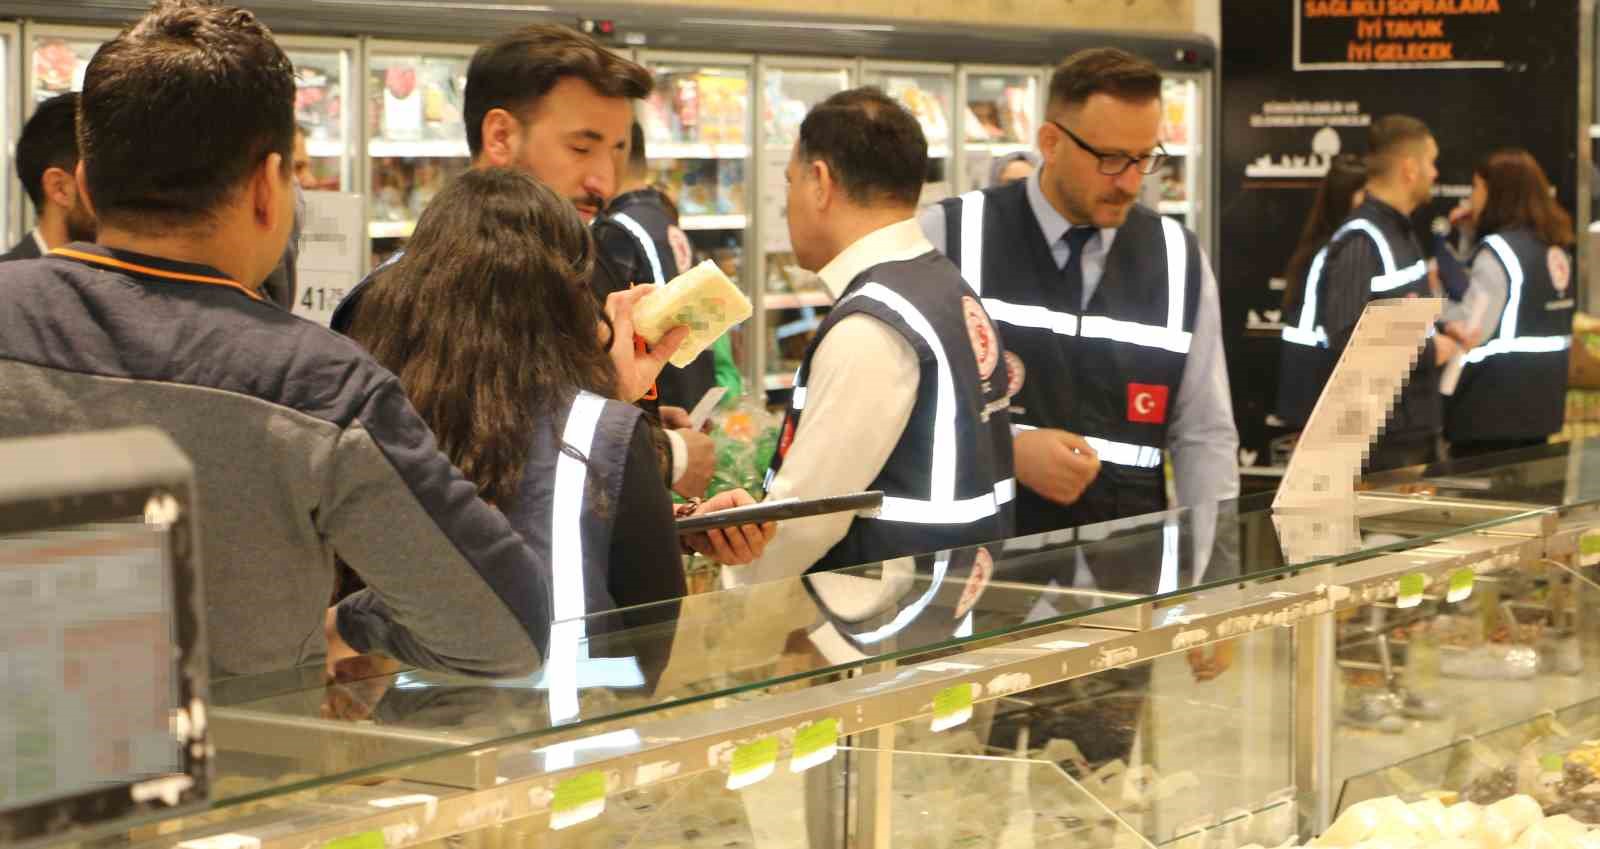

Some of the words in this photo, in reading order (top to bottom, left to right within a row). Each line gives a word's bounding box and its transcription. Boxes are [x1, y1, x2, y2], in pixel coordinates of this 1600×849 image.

[1384, 19, 1444, 37] TAVUK
[1374, 42, 1454, 60] GELECEK
[301, 286, 324, 310] 41
